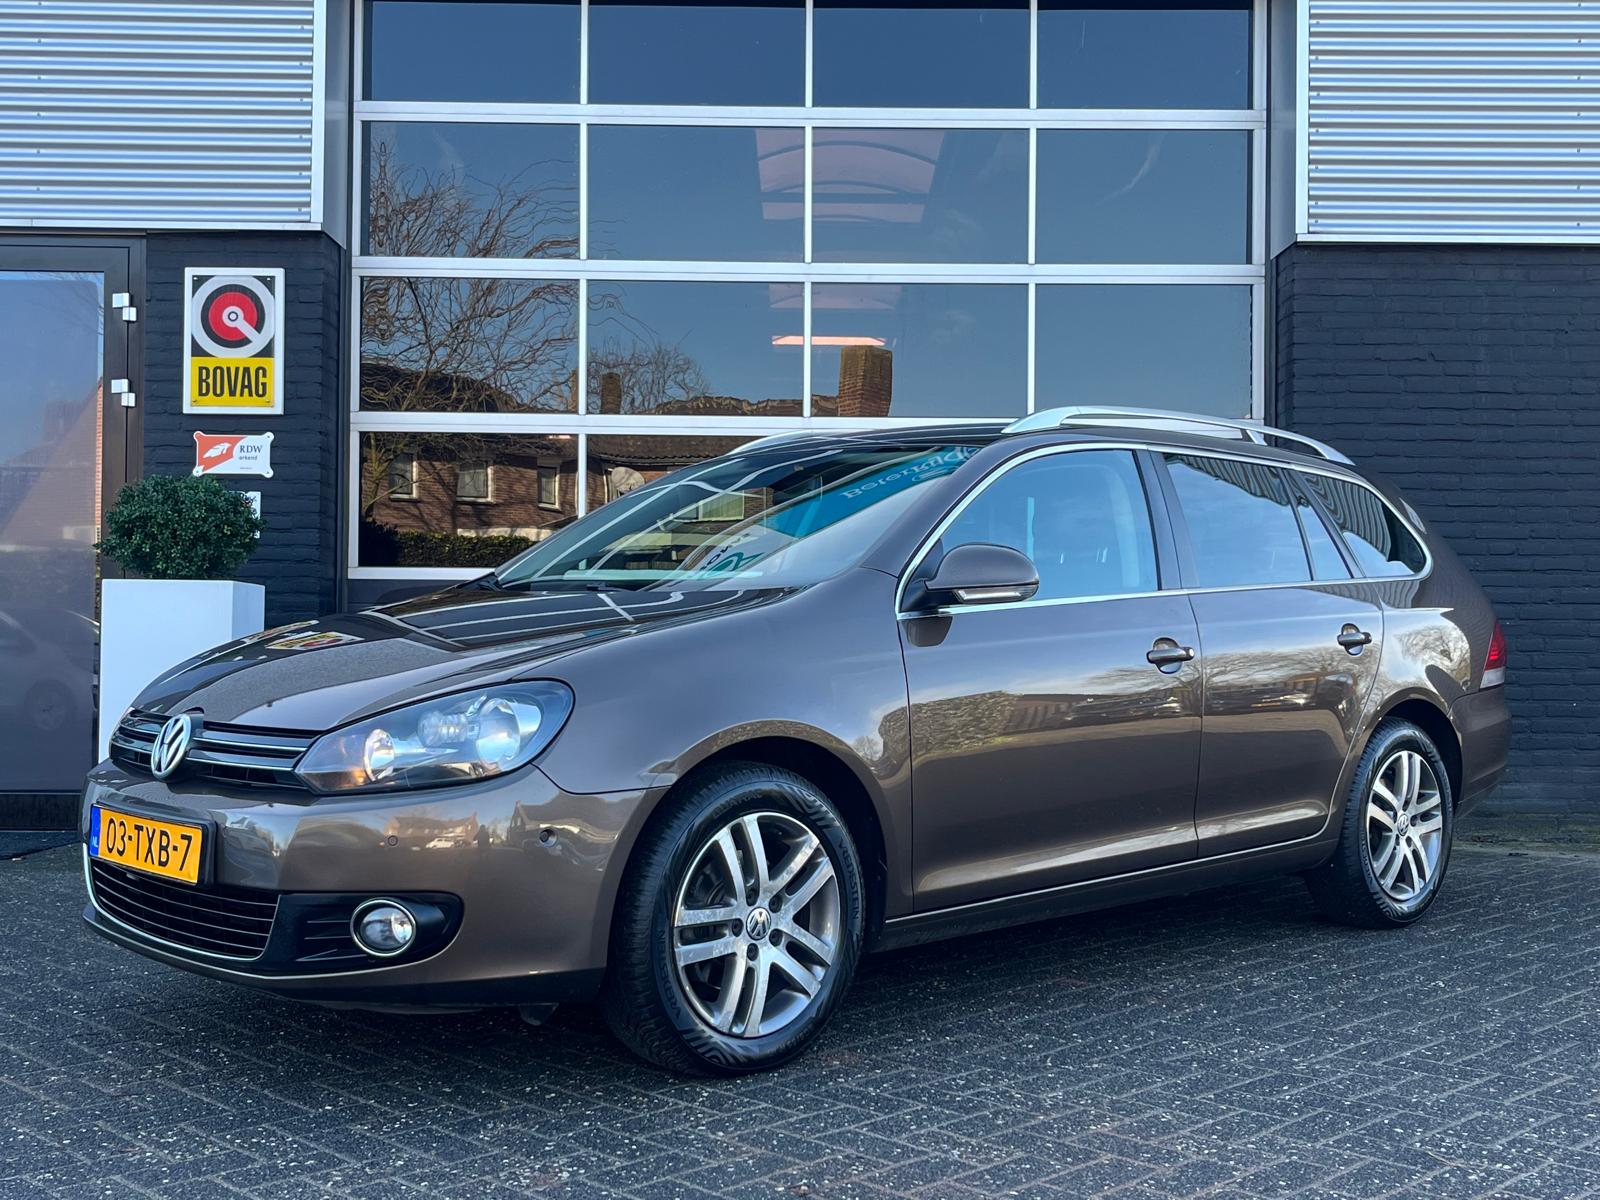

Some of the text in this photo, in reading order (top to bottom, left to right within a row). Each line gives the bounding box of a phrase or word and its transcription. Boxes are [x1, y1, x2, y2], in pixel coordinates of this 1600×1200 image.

[197, 365, 268, 398] BOVAG
[239, 444, 263, 454] RDW
[91, 835, 99, 848] NL
[106, 817, 193, 872] 03-TXB-7
[838, 836, 861, 920] VREDESTEIN
